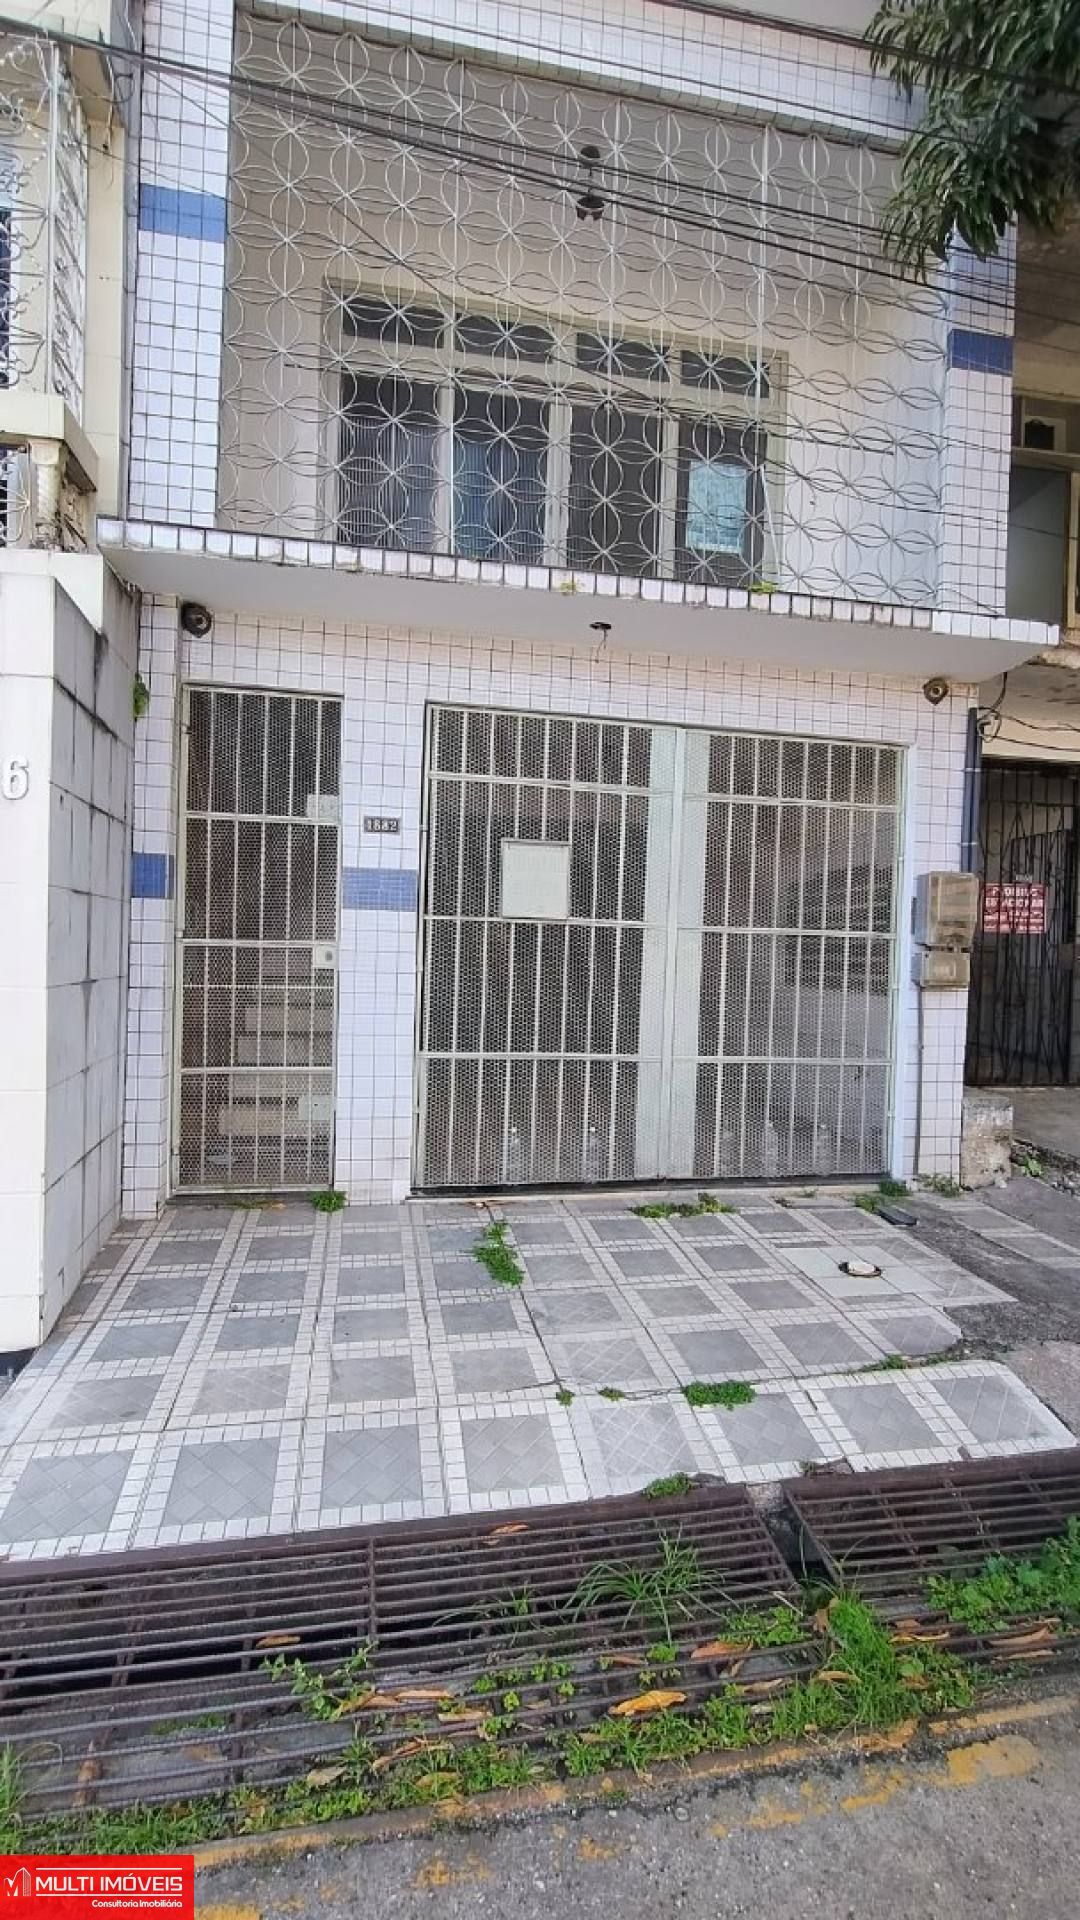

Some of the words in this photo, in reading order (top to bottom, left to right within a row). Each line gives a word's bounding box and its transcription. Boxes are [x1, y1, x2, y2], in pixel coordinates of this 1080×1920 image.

[2, 756, 29, 801] 6
[992, 886, 1039, 897] POIBIO
[985, 897, 1044, 908] ESACIONAR
